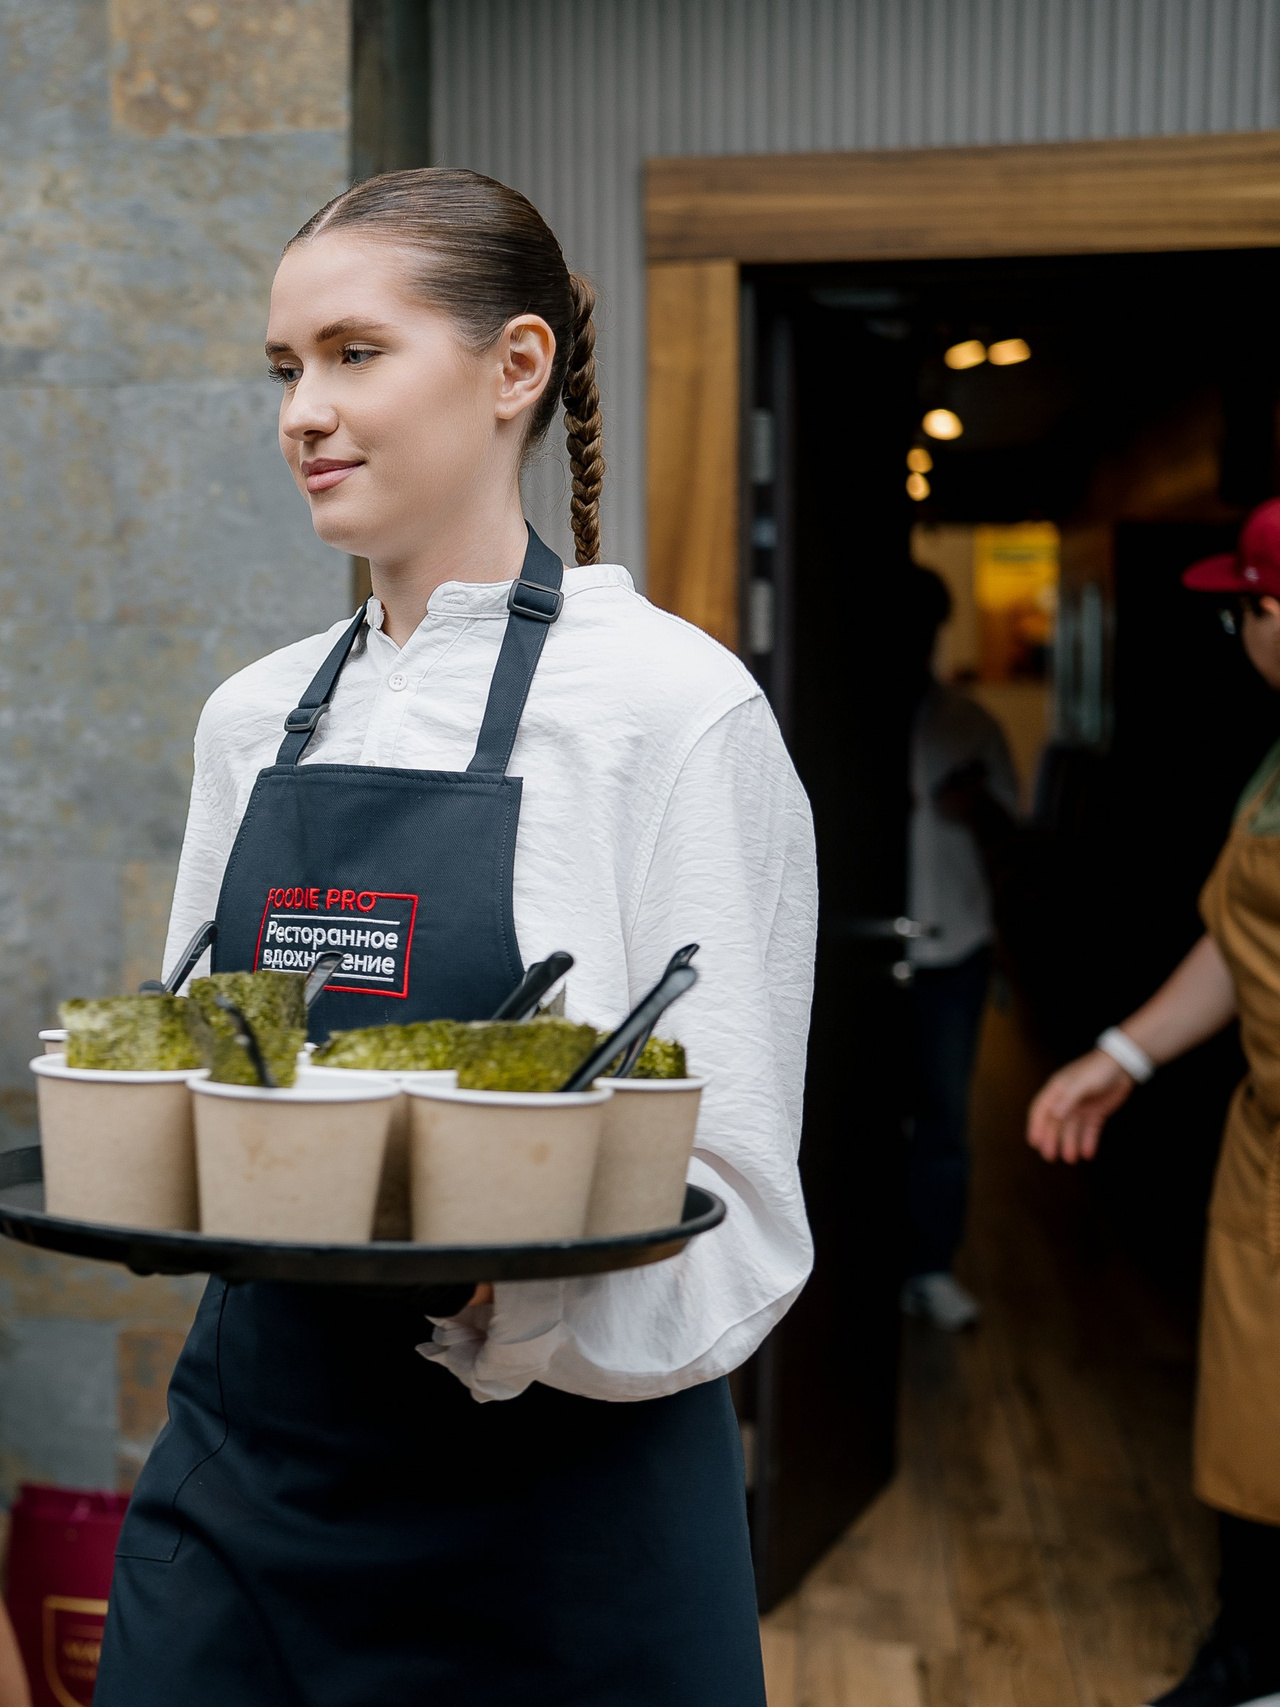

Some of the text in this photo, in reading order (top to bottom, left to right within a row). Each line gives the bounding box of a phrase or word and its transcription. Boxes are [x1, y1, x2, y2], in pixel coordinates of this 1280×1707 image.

[268, 887, 376, 912] FOODIE PRO
[266, 920, 398, 950] Ресторанное
[262, 949, 395, 975] вдохнение
